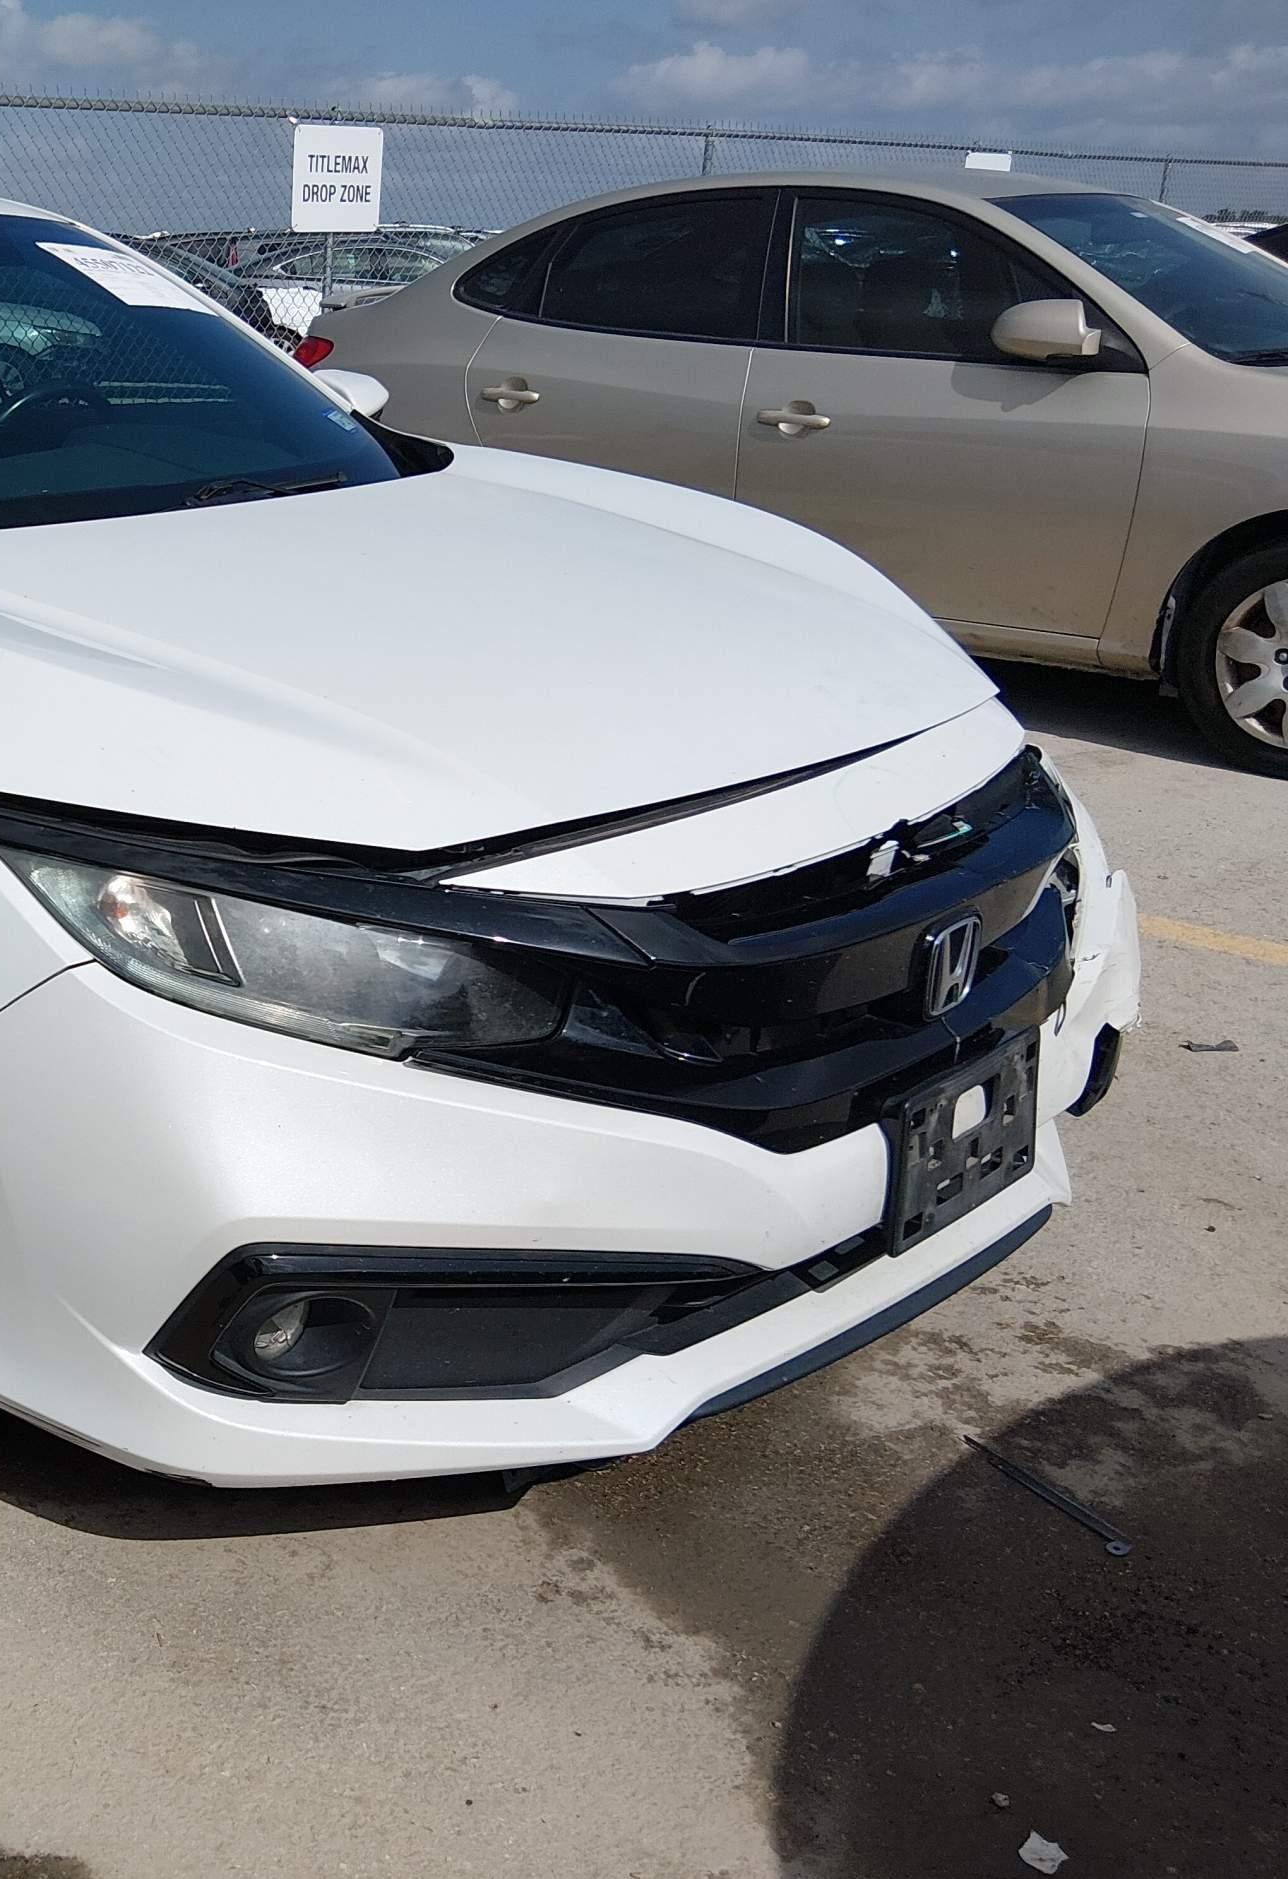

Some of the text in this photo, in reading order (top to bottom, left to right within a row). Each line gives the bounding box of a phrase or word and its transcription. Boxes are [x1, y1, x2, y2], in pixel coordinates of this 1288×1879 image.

[307, 154, 369, 174] TITLEMAX
[302, 184, 372, 203] DROP ZONE
